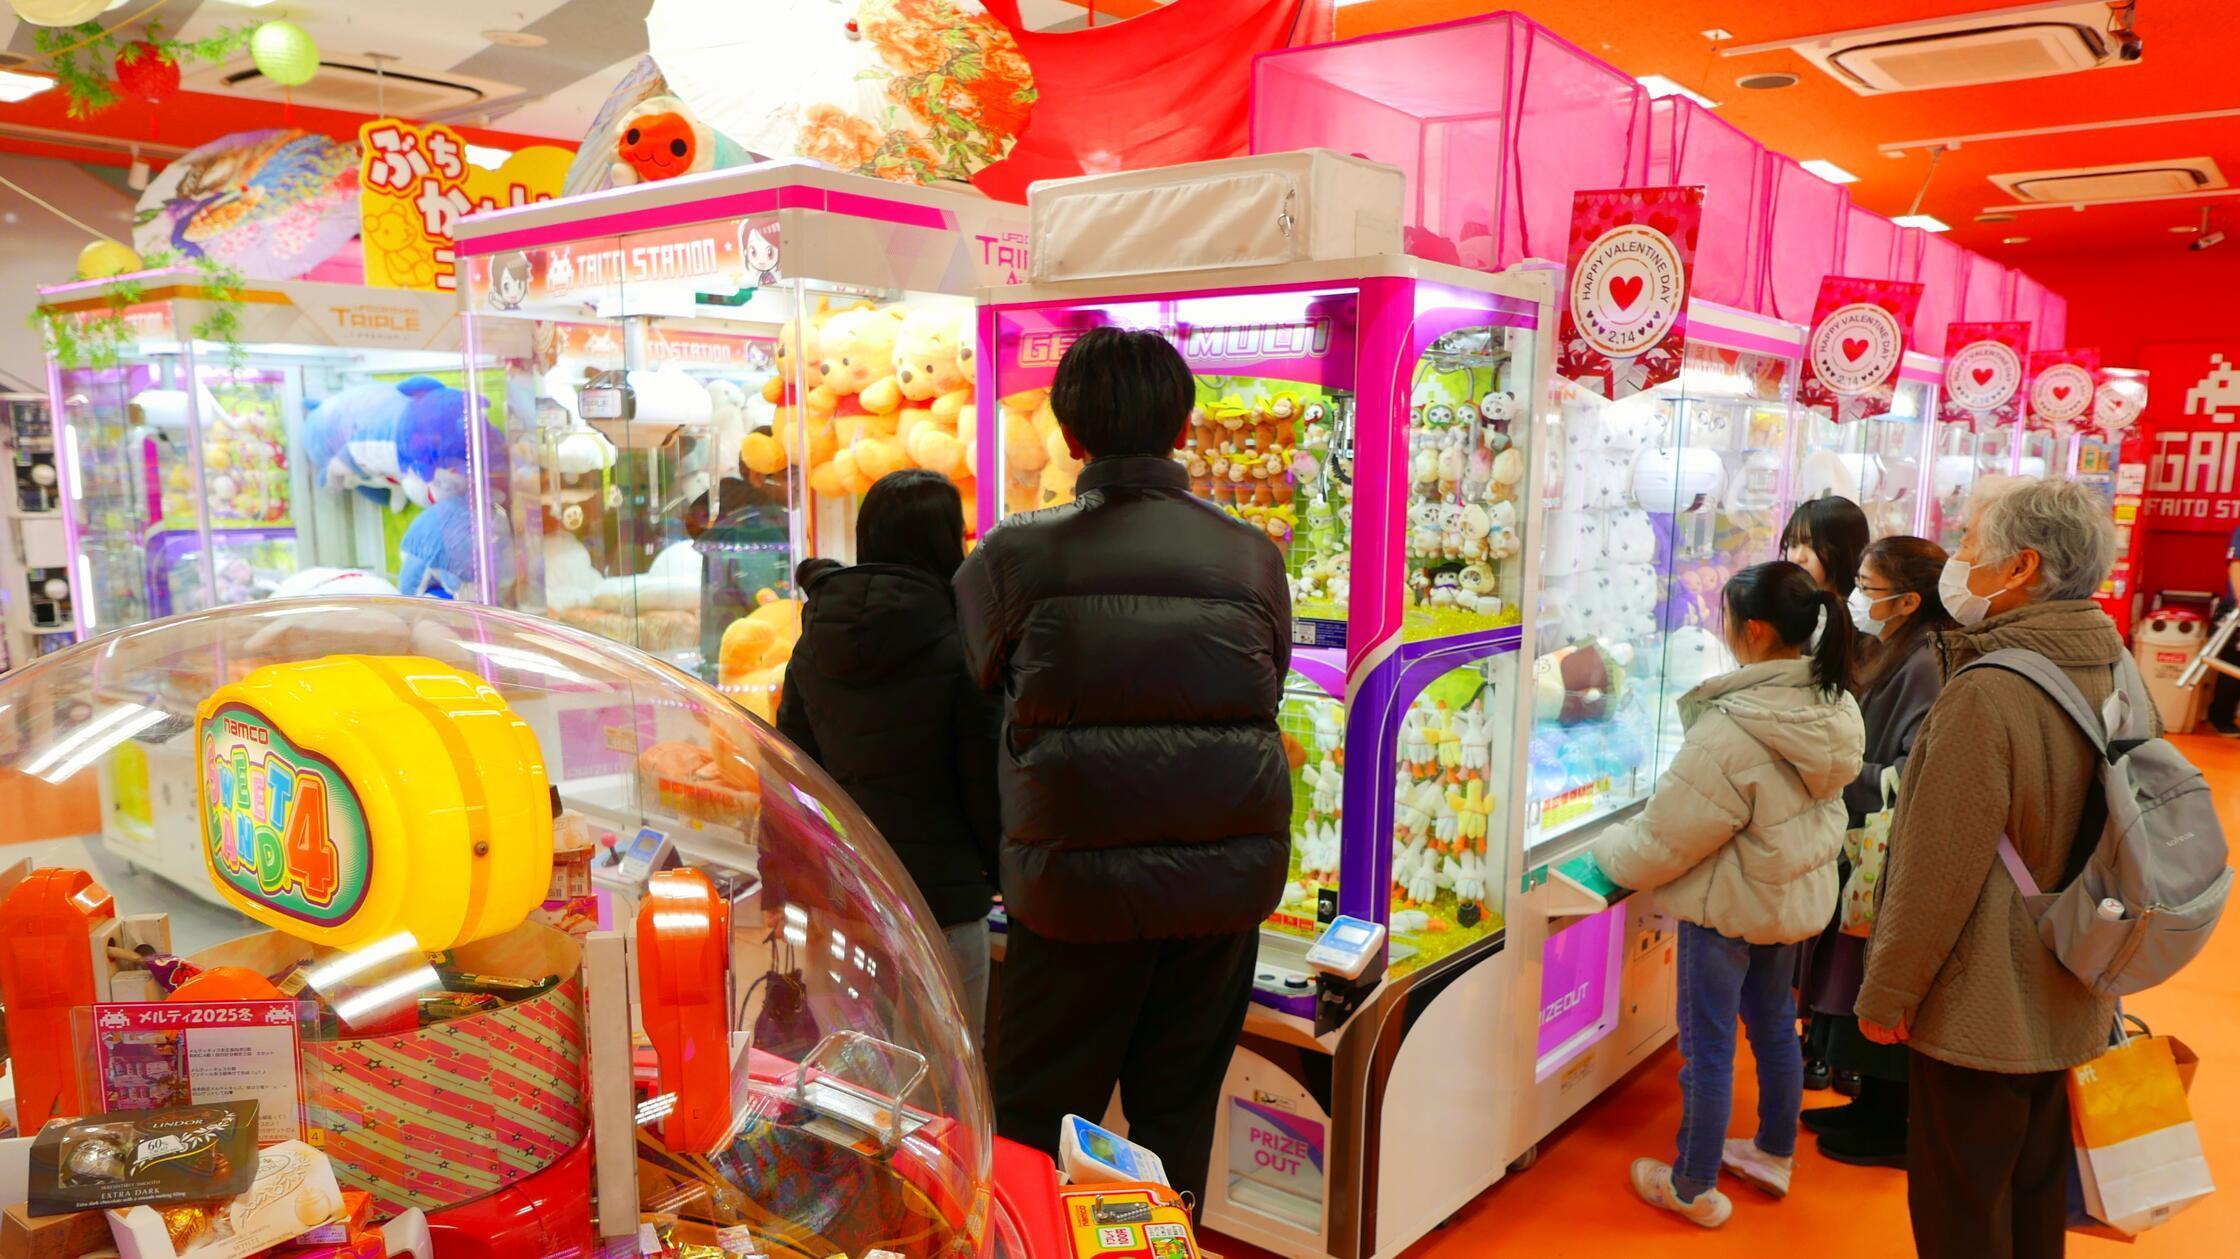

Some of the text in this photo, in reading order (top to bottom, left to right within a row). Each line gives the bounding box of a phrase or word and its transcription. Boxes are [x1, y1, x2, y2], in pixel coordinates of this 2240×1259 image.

[577, 237, 718, 286] TAITO STATION
[1582, 241, 1671, 304] HAPPY VALENTINE DAY
[1187, 317, 1331, 358] MULTI
[1608, 330, 1636, 345] 2.14
[1821, 315, 1891, 361] HAPPY VALENTINE DAY
[1836, 374, 1859, 386] 2.14
[223, 716, 269, 746] namco
[205, 733, 294, 833] SWEET
[206, 778, 335, 900] LAND 4
[138, 1007, 254, 1024] メルティ2025冬
[152, 1119, 204, 1129] LINDOR
[311, 1131, 319, 1140] 4
[1249, 1127, 1308, 1159] PRIZE
[1254, 1149, 1302, 1177] OUT
[101, 1187, 161, 1200] EXTRA DARK
